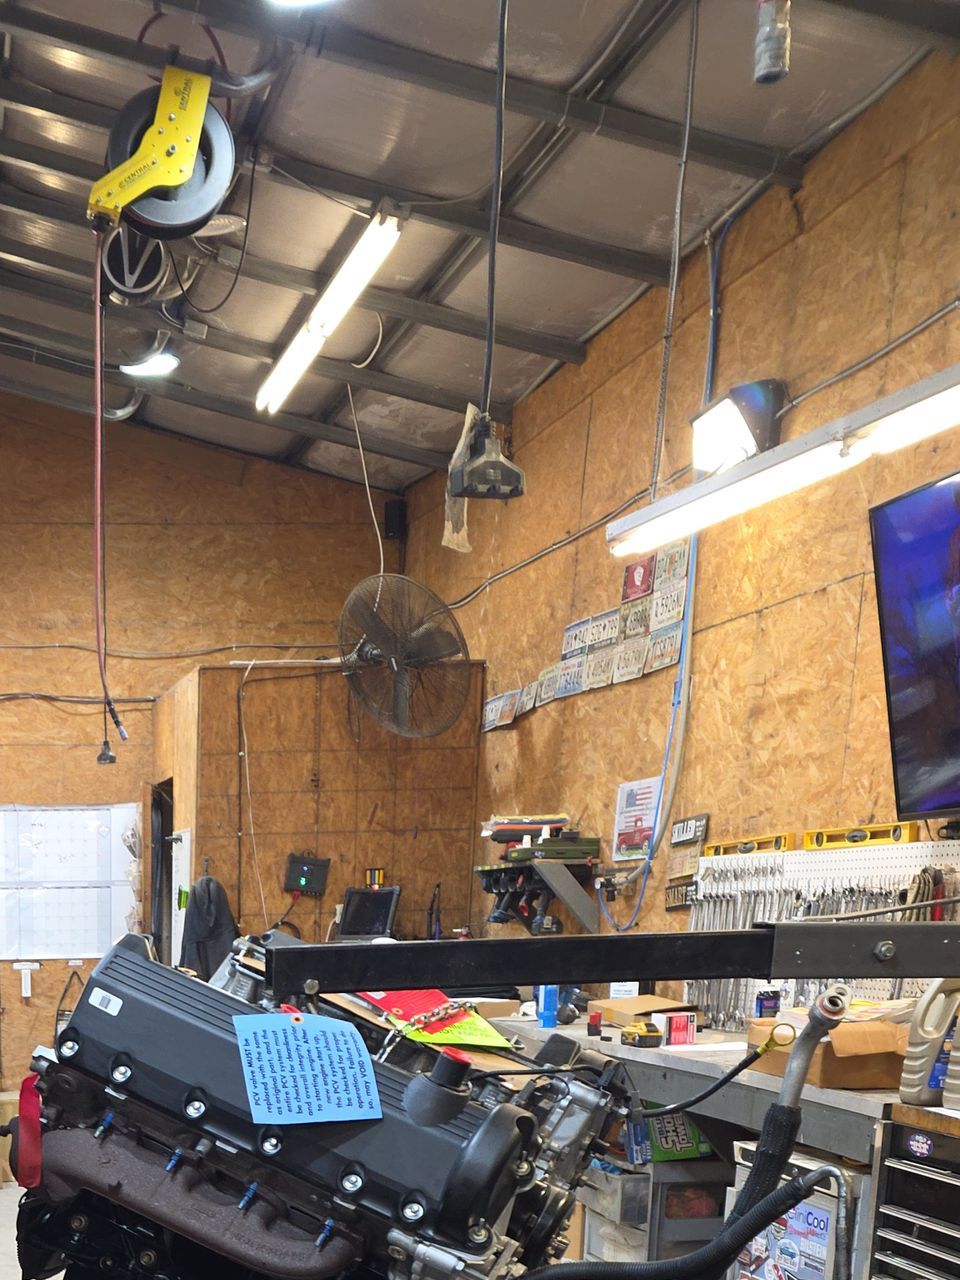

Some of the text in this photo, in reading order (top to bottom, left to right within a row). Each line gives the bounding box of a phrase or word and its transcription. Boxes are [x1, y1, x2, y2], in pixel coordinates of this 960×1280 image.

[124, 163, 151, 183] CENTRAL
[252, 1031, 260, 1048] same
[291, 1026, 300, 1041] prior
[301, 1028, 309, 1044] After
[321, 1030, 330, 1051] should
[332, 1032, 342, 1051] proper
[281, 1028, 293, 1061] cleanliness
[245, 1049, 253, 1067] MUST
[276, 1049, 286, 1071] system
[294, 1044, 307, 1071] integrity
[327, 1053, 338, 1077] system
[345, 1047, 355, 1069] Failure
[258, 1064, 266, 1078] with
[319, 1063, 329, 1085] engine
[359, 1060, 367, 1077] VOID
[249, 1070, 257, 1089] valve
[270, 1075, 282, 1103] original
[280, 1074, 288, 1088] PCV
[290, 1075, 301, 1102] checked
[300, 1074, 310, 1098] overall
[310, 1073, 322, 1100] starting
[340, 1066, 350, 1094] checked
[364, 1080, 373, 1096] may
[253, 1092, 261, 1105] PCV
[261, 1081, 273, 1113] replaced
[284, 1091, 293, 1112] entire
[655, 1117, 666, 1137] BLU
[673, 1112, 694, 1152] TOWEL
